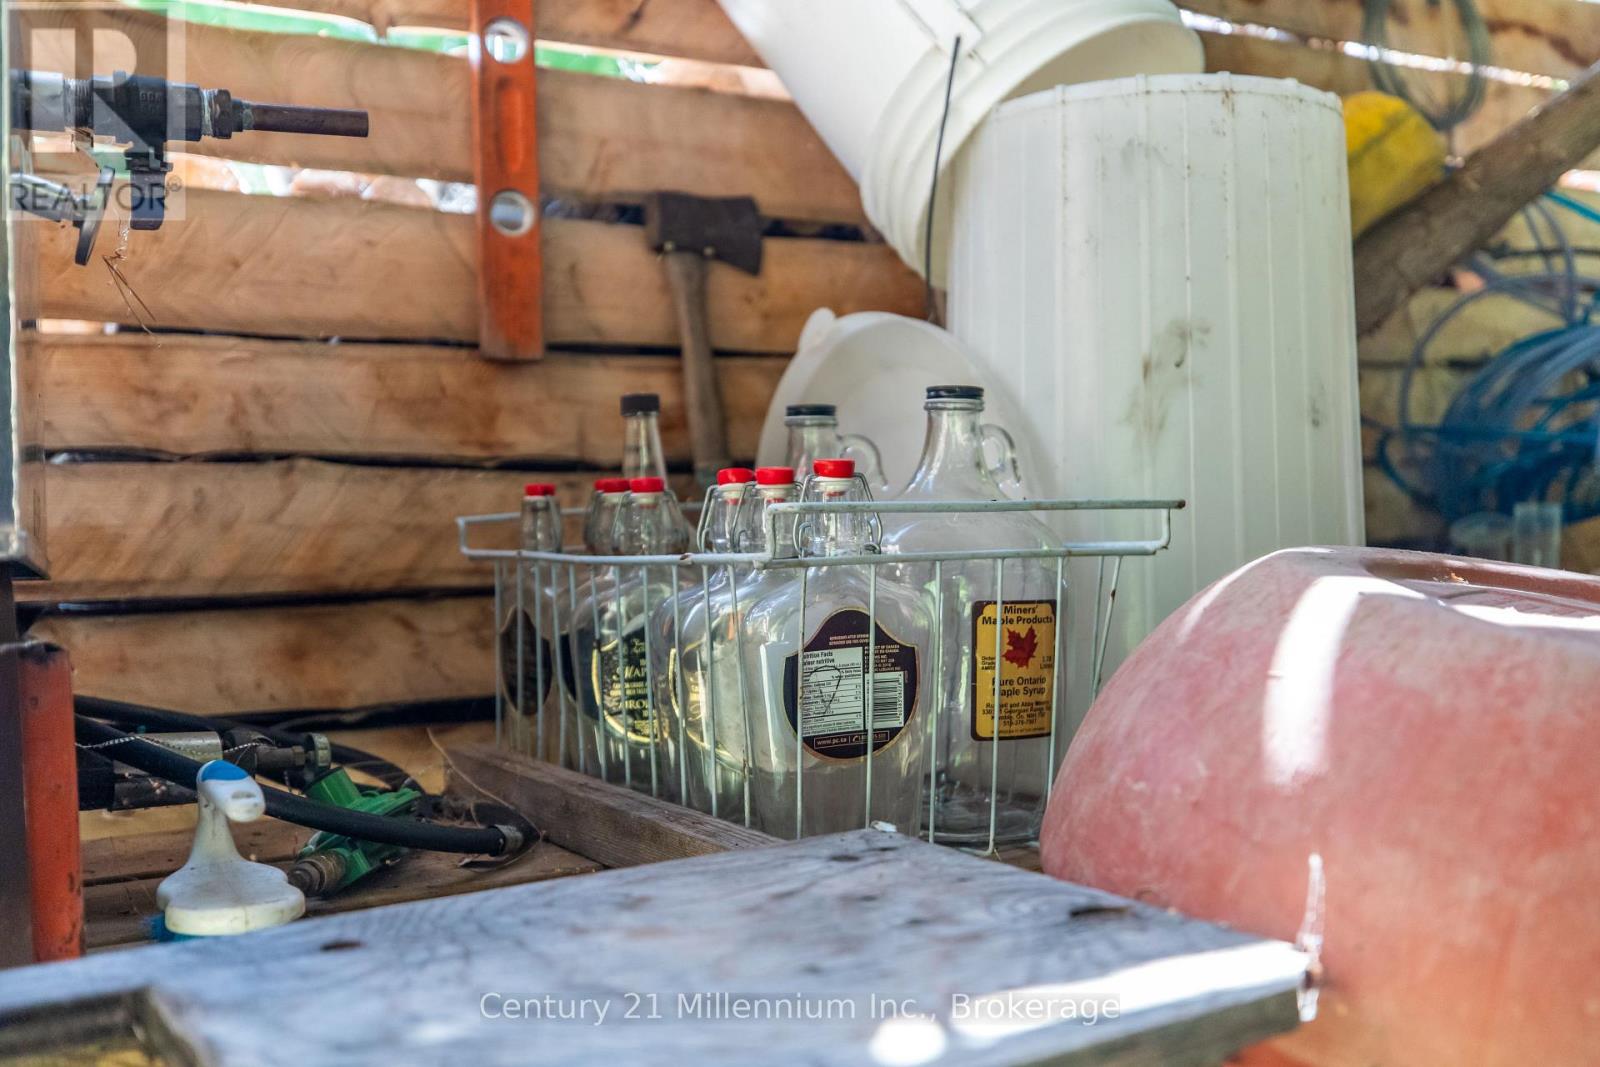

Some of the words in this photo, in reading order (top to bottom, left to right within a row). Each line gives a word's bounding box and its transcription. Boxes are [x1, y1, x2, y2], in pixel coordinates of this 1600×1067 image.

[1003, 604, 1038, 614] Miners'
[1017, 675, 1046, 685] Ontario
[993, 687, 1020, 698] aple
[1023, 685, 1046, 697] Syrup
